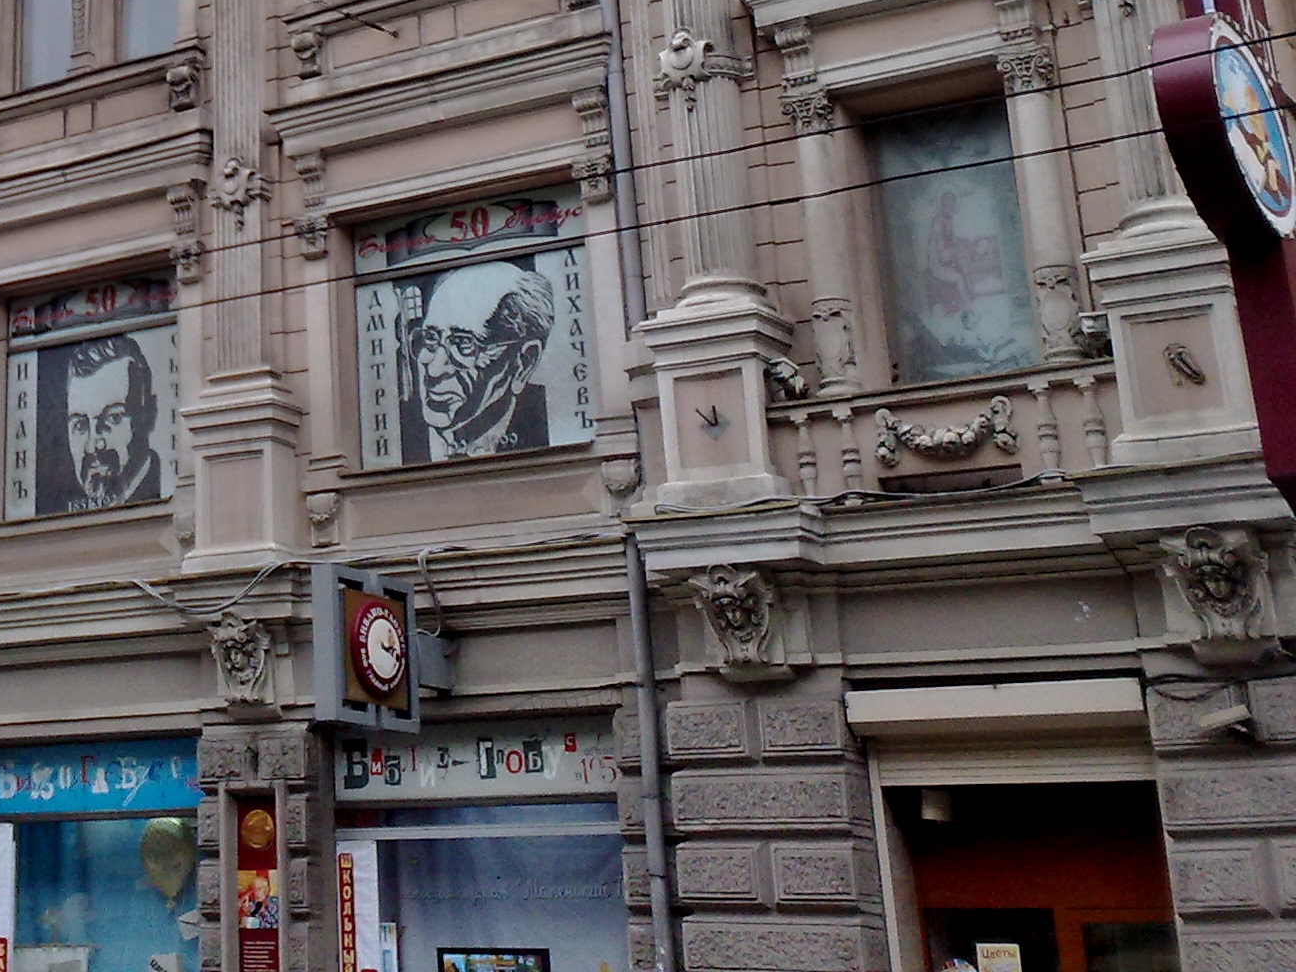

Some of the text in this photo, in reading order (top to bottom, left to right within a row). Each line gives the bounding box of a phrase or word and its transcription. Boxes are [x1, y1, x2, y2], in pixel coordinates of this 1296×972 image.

[450, 206, 490, 243] 50
[85, 284, 117, 317] 50
[366, 288, 390, 458] ДМИТРИЙ
